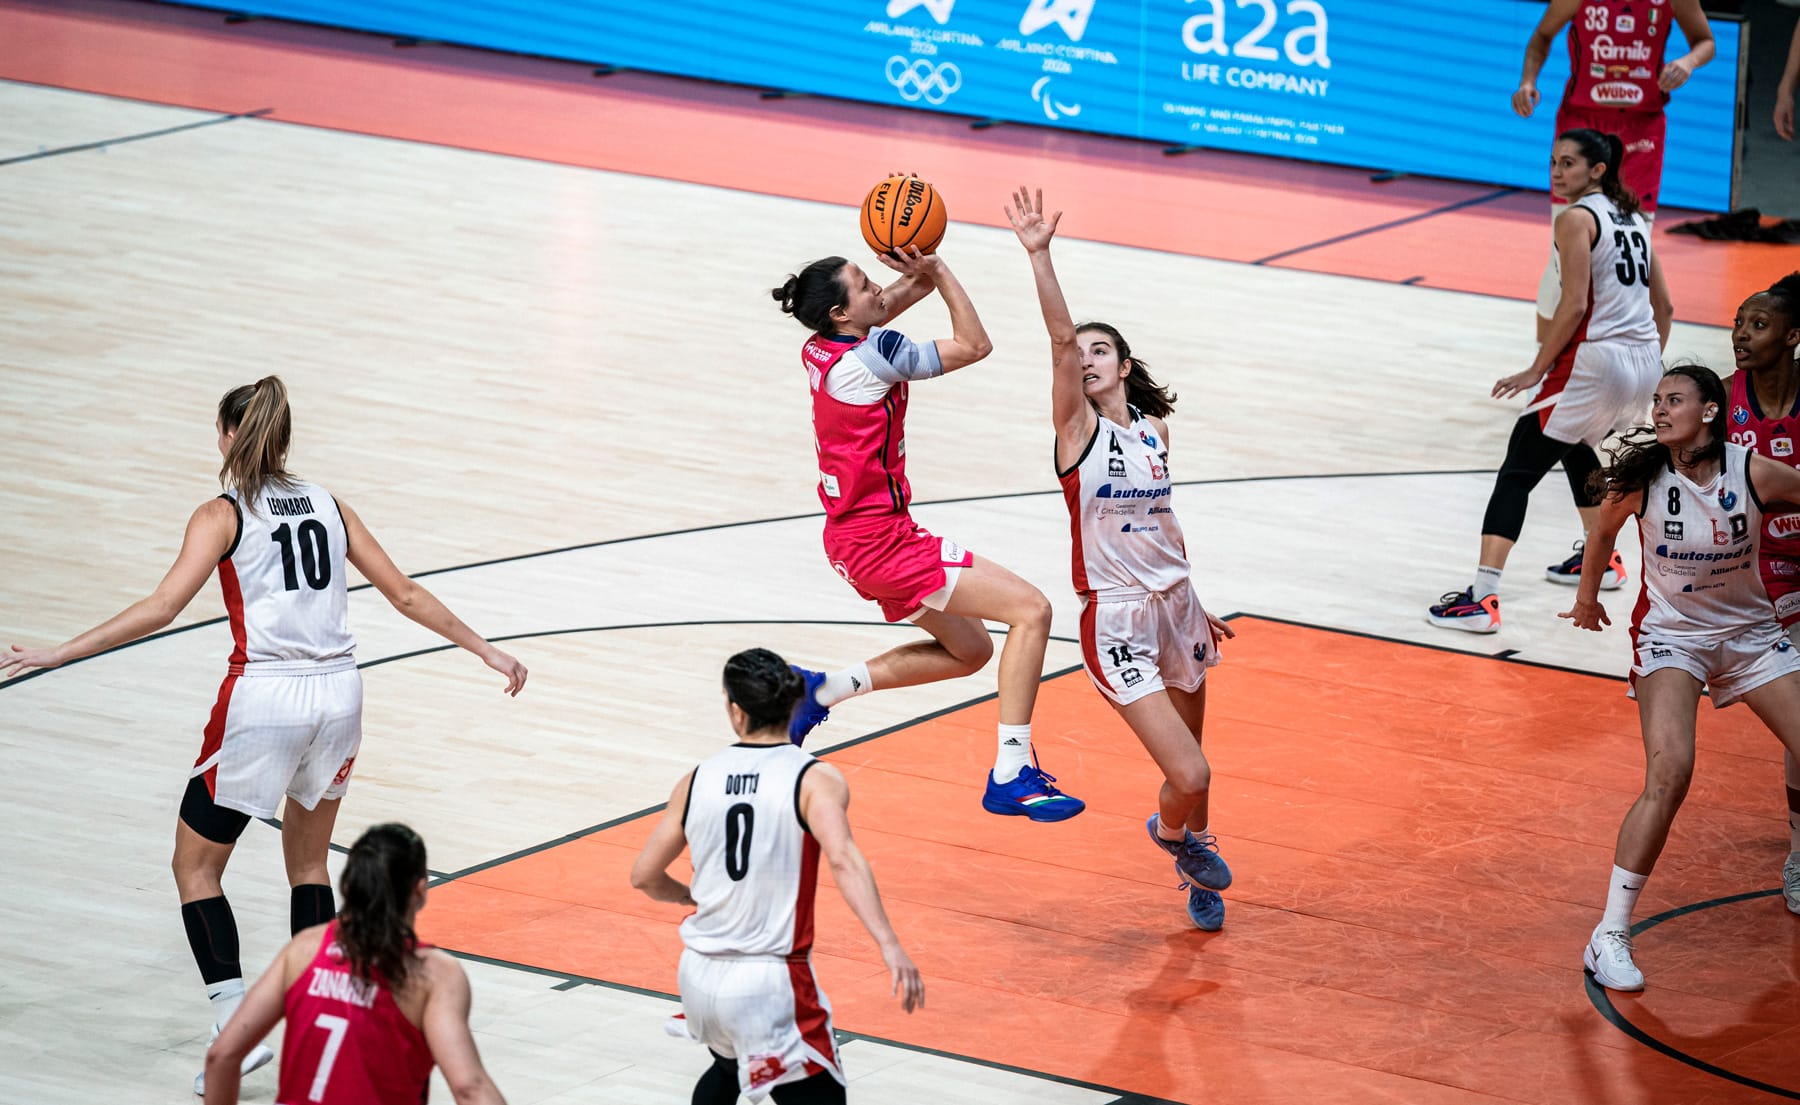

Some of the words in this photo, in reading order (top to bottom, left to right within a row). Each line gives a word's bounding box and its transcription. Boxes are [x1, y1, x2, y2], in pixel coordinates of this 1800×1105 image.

[1585, 6, 1609, 31] 33
[1182, 0, 1331, 69] a2a
[1182, 62, 1220, 85] LIFE
[1226, 67, 1328, 97] COMPANY
[1596, 86, 1639, 99] Wüber
[875, 183, 891, 211] EVO
[898, 180, 924, 227] Wilson
[1614, 230, 1649, 287] 33
[266, 496, 315, 516] LEONARDI
[1101, 507, 1135, 516] Cittadella
[1668, 486, 1681, 516] 8
[271, 519, 331, 591] 10
[1669, 548, 1743, 562] autosped
[1662, 565, 1696, 577] Cittadella
[1710, 564, 1739, 576] Allianz
[1108, 646, 1132, 667] 14
[725, 802, 754, 882] 0
[308, 1013, 349, 1103] 7
